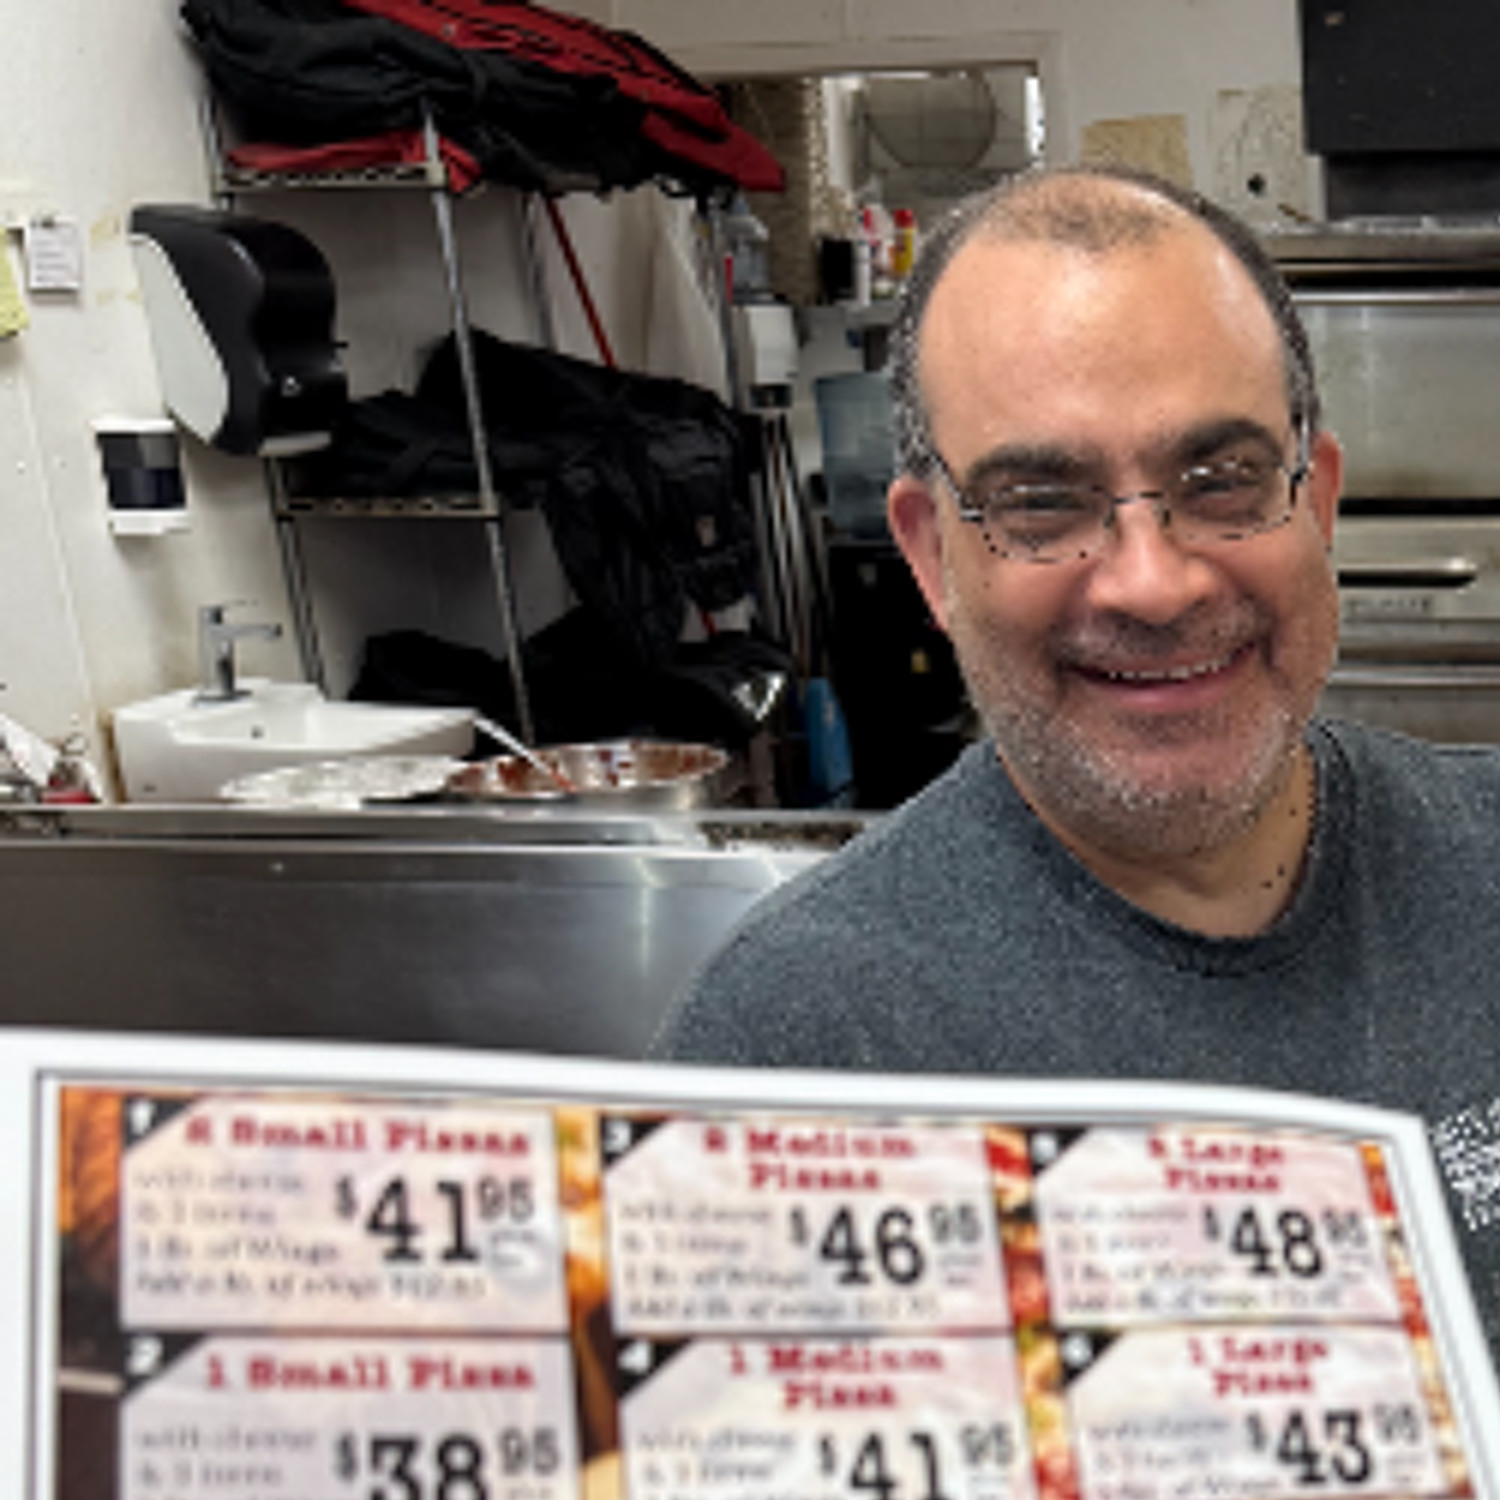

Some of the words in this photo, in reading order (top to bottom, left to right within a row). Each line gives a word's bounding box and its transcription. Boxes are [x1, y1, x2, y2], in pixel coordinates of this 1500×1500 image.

[232, 1117, 367, 1151] Small
[384, 1121, 529, 1156] Pizzas
[748, 1127, 915, 1158] Medium
[1182, 1139, 1285, 1167] Large
[749, 1163, 880, 1190] Pizzas
[768, 1345, 943, 1374] Medium
[1220, 1337, 1328, 1364] Large
[248, 1356, 390, 1391] Small
[408, 1356, 534, 1391] Pizza
[783, 1381, 896, 1410] Pizza
